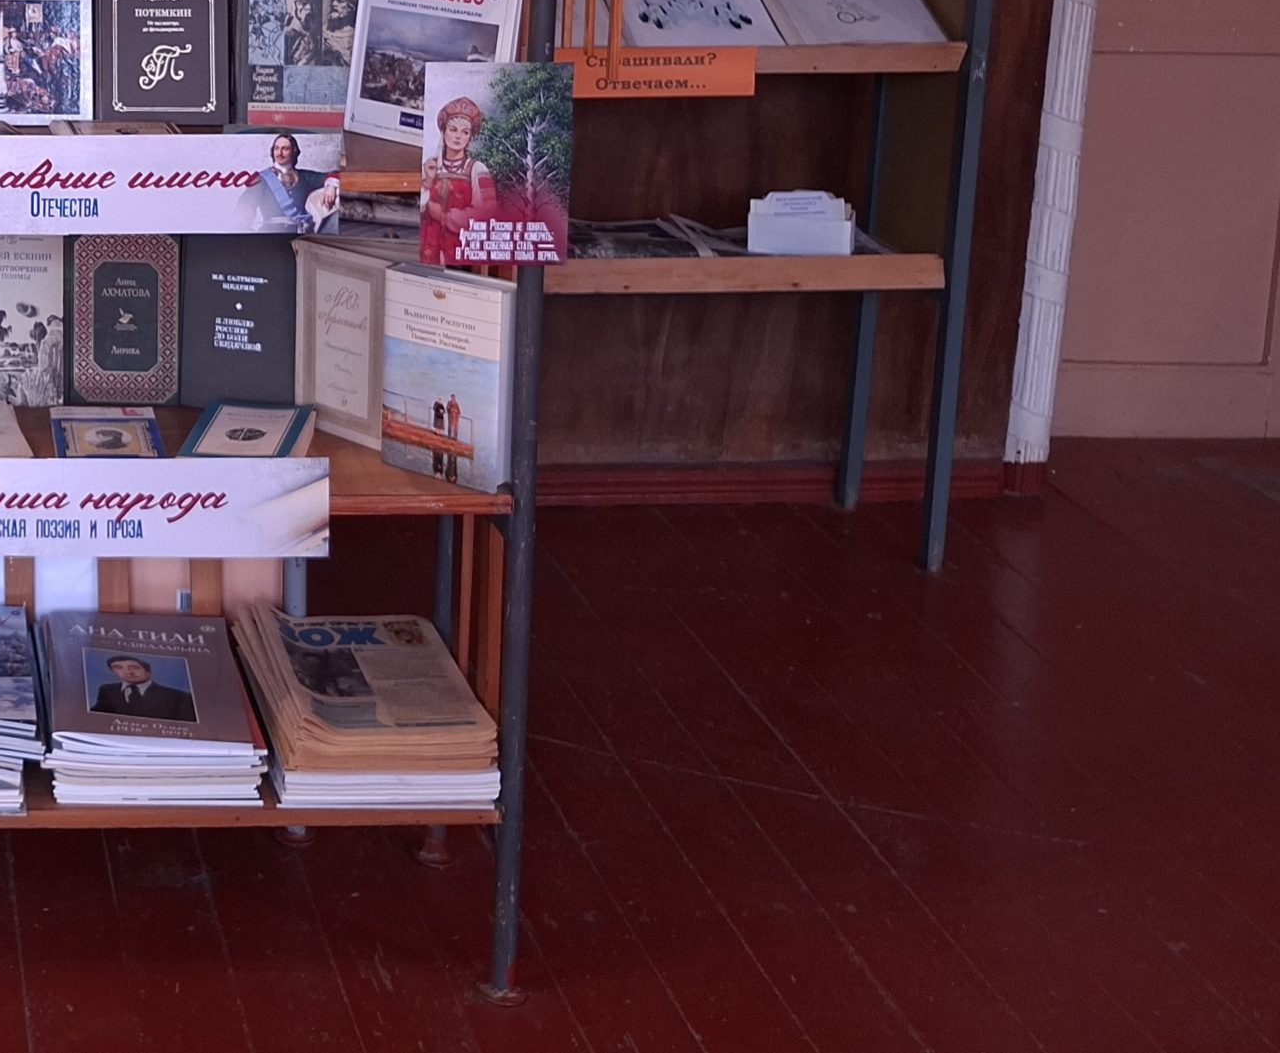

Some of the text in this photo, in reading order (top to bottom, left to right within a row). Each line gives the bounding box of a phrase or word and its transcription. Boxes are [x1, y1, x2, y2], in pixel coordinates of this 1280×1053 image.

[134, 8, 192, 17] ПОТЕМКИН
[585, 52, 717, 69] Спашивали?
[128, 169, 262, 190] имена
[13, 252, 53, 261] ЕСЕНИН
[101, 288, 151, 298] АХМАТОВА
[79, 490, 229, 524] народа
[36, 519, 81, 539] ПОЭЗИЯ
[90, 519, 97, 538] И
[106, 519, 143, 539] ПРОЗА
